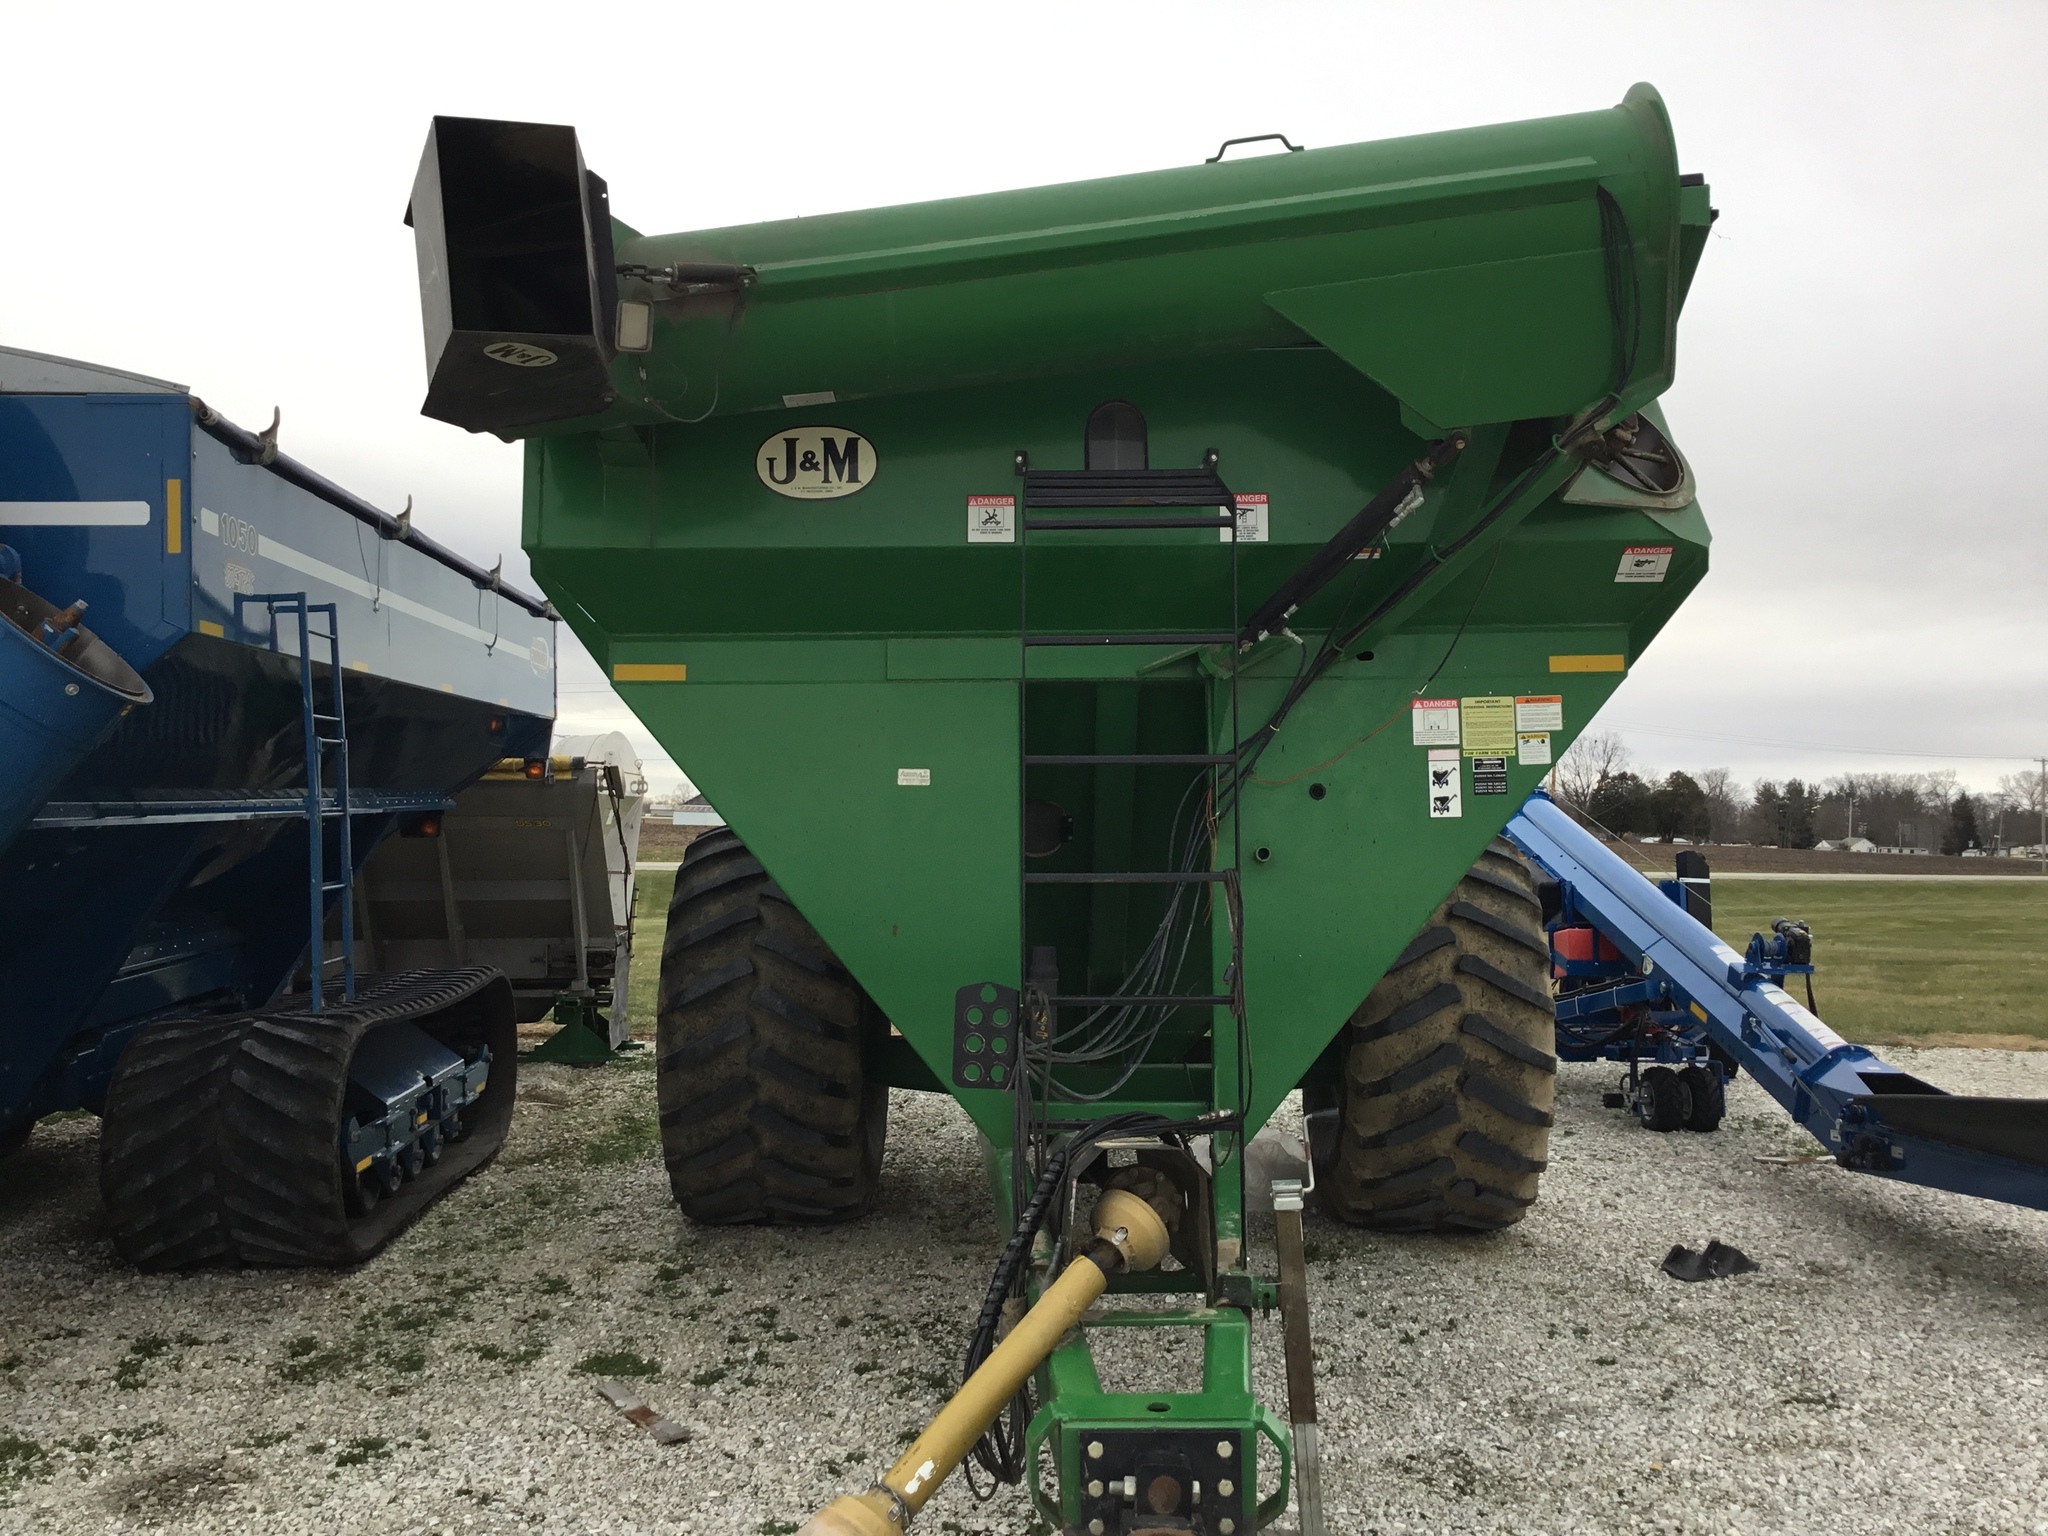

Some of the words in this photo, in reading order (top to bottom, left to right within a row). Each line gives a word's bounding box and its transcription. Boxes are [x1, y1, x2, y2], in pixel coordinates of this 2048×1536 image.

[486, 344, 552, 364] J&M
[765, 437, 862, 485] J&M
[977, 497, 1015, 506] DANGER
[1235, 494, 1268, 503] ANGER
[220, 511, 258, 556] 1050
[1633, 546, 1674, 555] DANGER
[1422, 700, 1458, 708] DANGER
